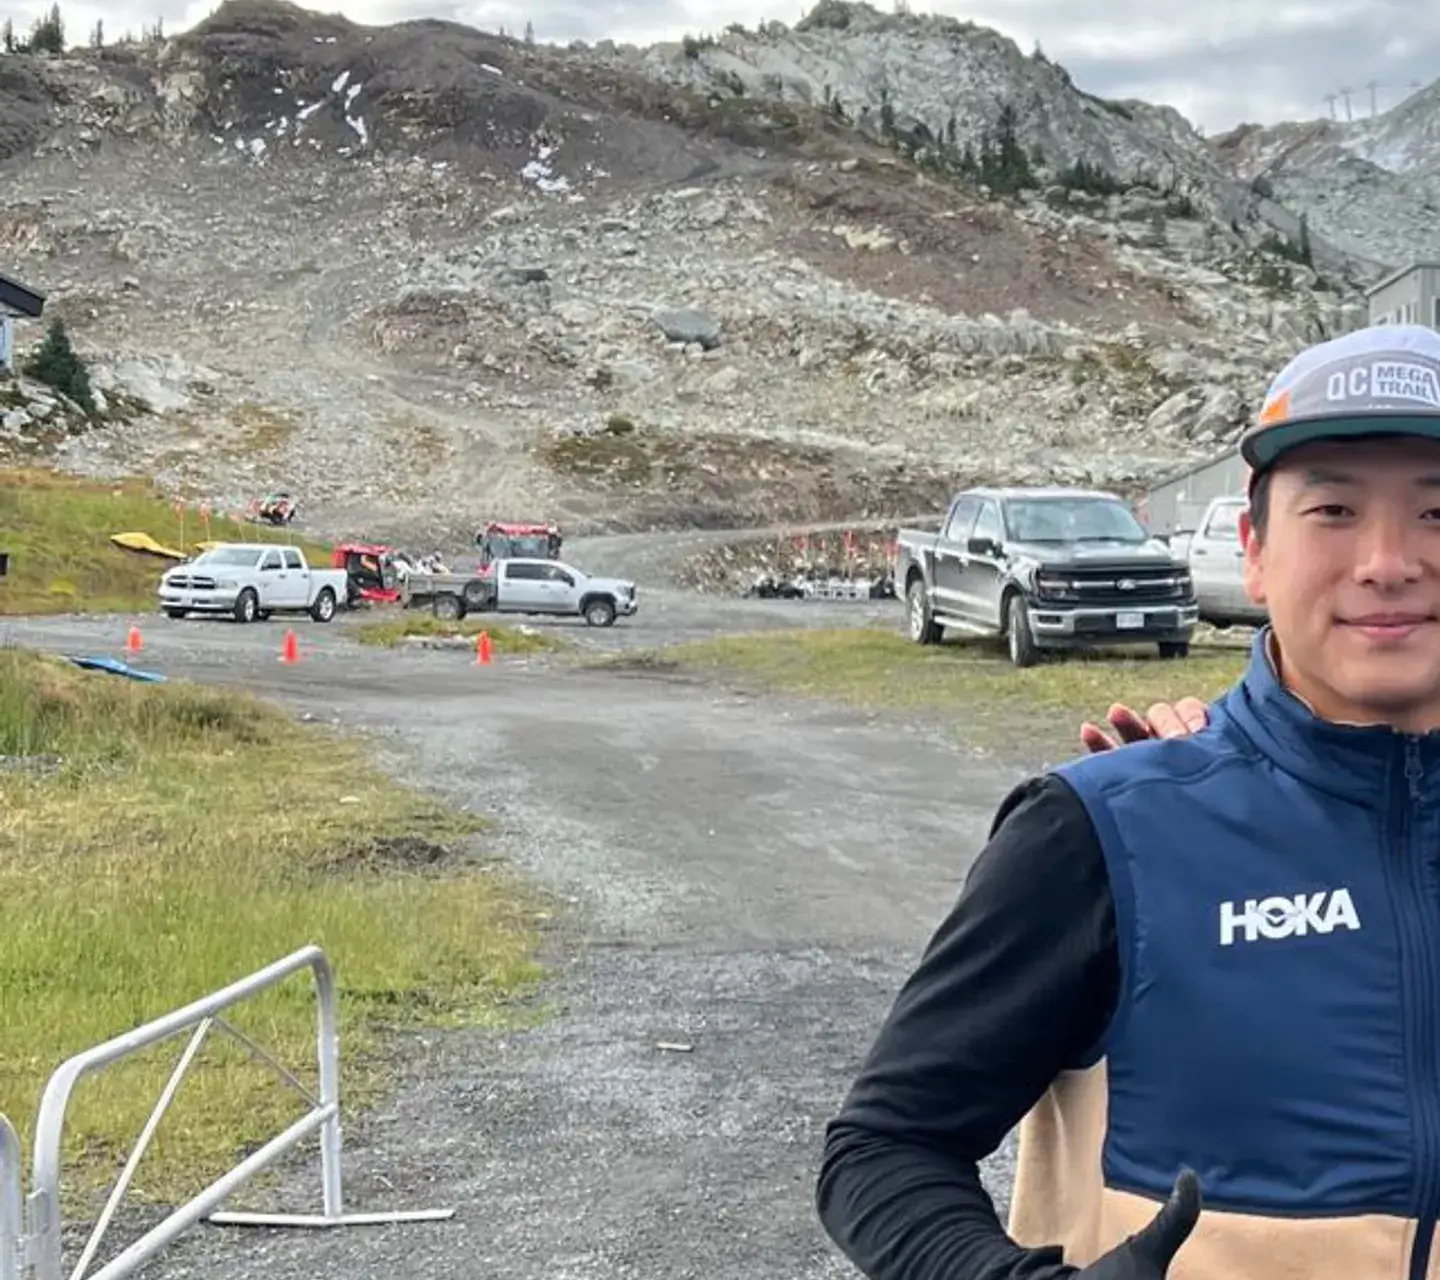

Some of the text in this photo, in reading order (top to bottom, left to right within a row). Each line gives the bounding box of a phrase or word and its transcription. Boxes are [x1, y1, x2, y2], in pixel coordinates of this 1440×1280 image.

[1376, 364, 1435, 382] MEGA
[1379, 380, 1430, 398] TRAIL
[1219, 887, 1361, 946] HOKA
